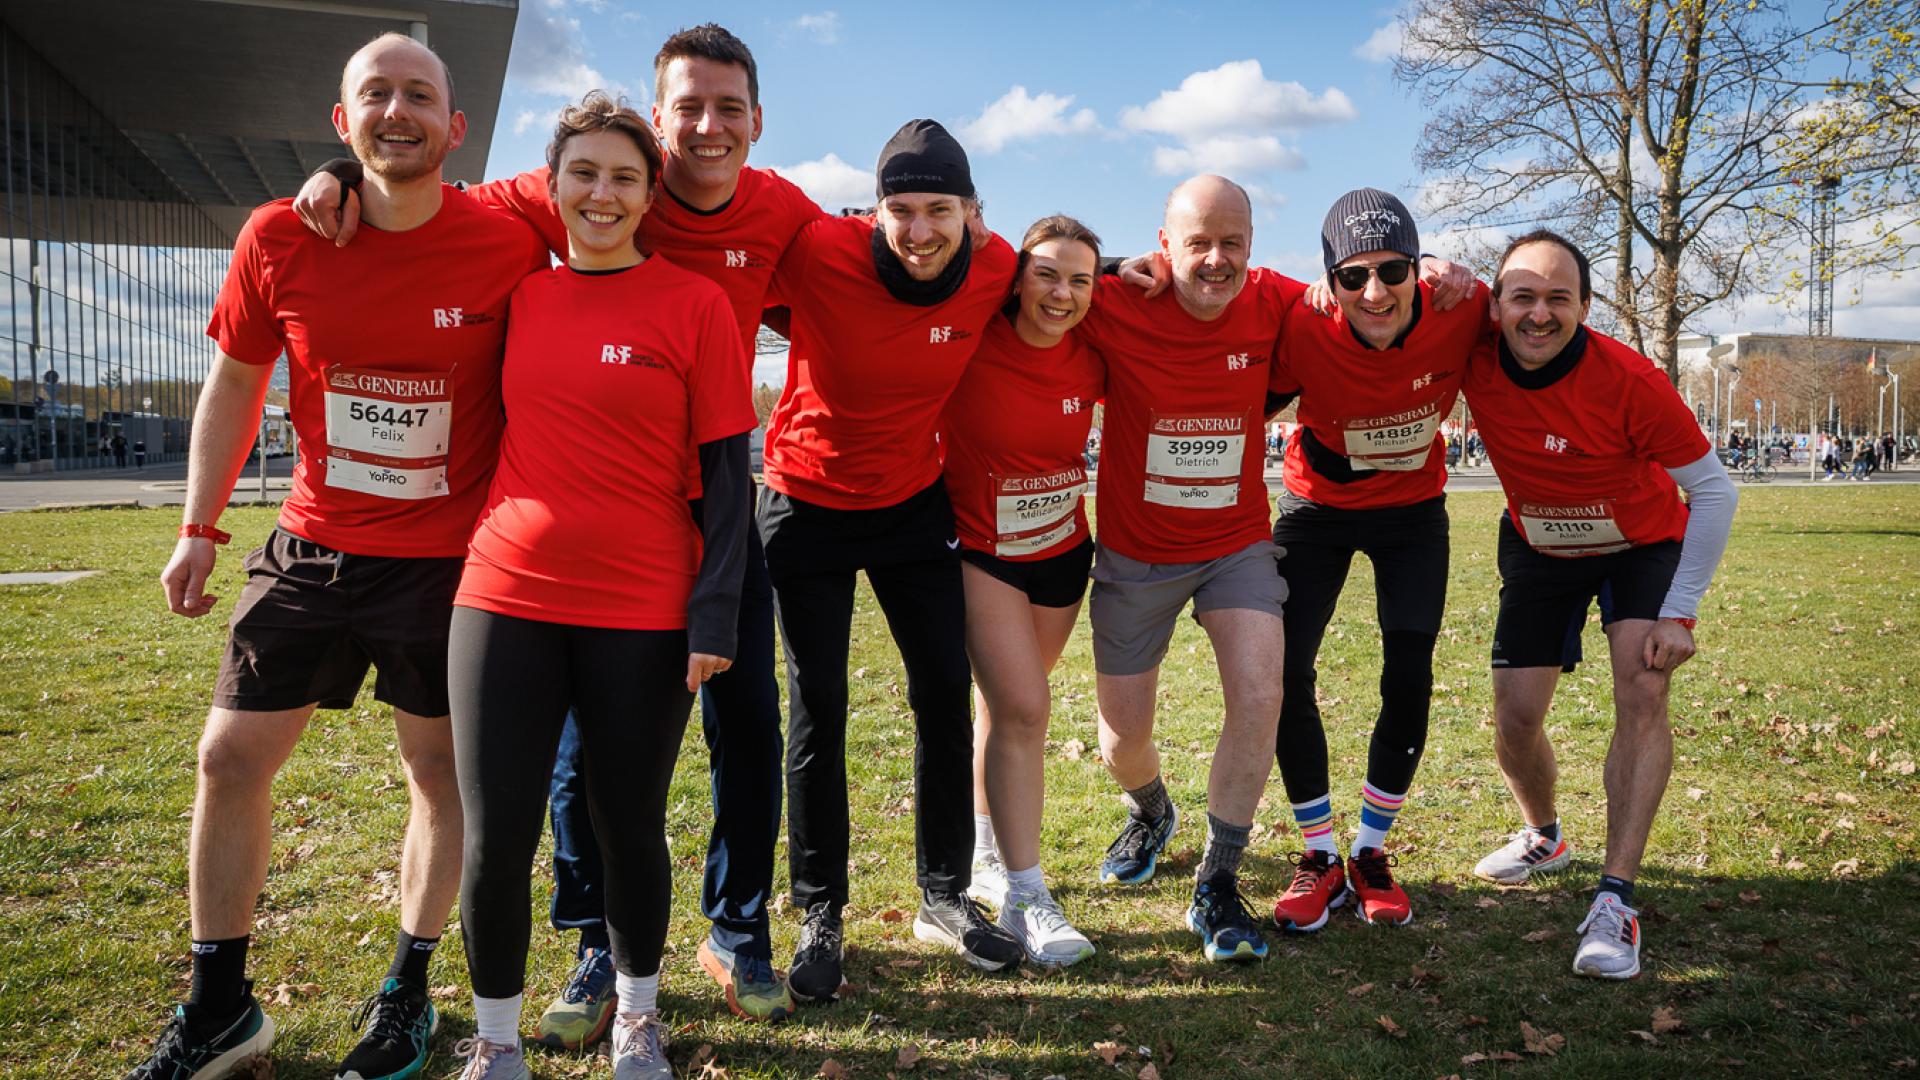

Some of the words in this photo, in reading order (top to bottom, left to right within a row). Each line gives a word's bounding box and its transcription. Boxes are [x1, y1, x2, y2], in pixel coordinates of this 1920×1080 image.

[1344, 210, 1400, 226] G-STAR
[1353, 223, 1391, 238] RAW
[433, 307, 463, 329] RSF
[601, 344, 632, 365] RSF
[358, 374, 446, 397] GENERALI
[350, 401, 429, 428] 56447
[1369, 402, 1436, 428] GENERALI
[1177, 417, 1242, 432] GENERALI
[1363, 422, 1425, 441] 14882
[372, 426, 405, 442] Felix
[1167, 439, 1228, 455] 39999
[1175, 456, 1219, 467] Dietrich
[369, 470, 407, 485] YoPRO
[1023, 467, 1082, 491] GENERALI
[1179, 488, 1209, 498] YoPRO
[1538, 503, 1606, 517] GENERALI
[1542, 521, 1594, 532] 21110
[191, 943, 218, 955] ep
[412, 941, 438, 951] ce
